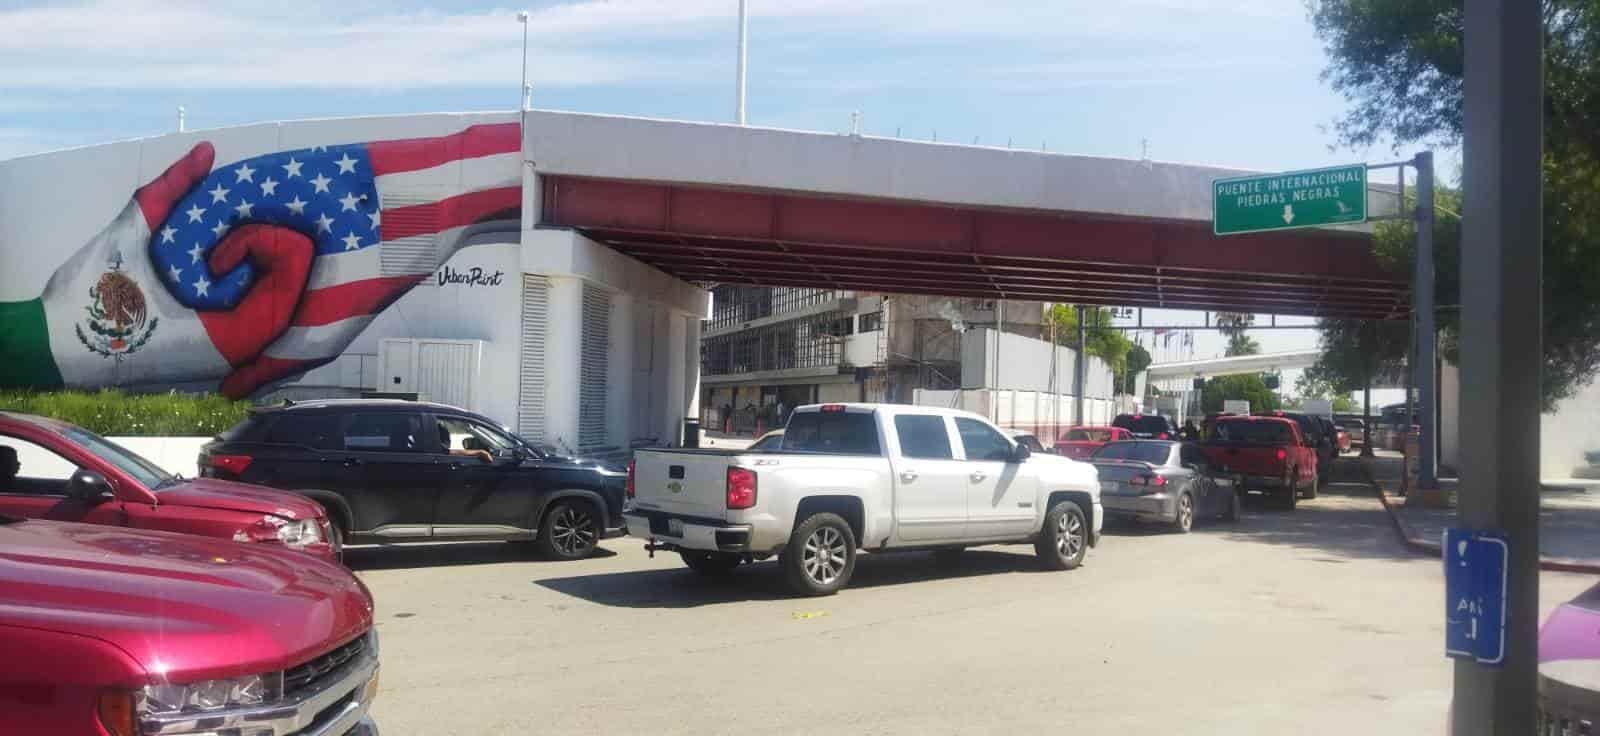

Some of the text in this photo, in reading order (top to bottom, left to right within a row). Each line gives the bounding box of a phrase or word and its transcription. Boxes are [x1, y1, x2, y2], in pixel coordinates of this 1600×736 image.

[1218, 171, 1360, 195] PUENTE INTERNACIONAL
[1238, 187, 1339, 207] PIEDRAS NEGRAS
